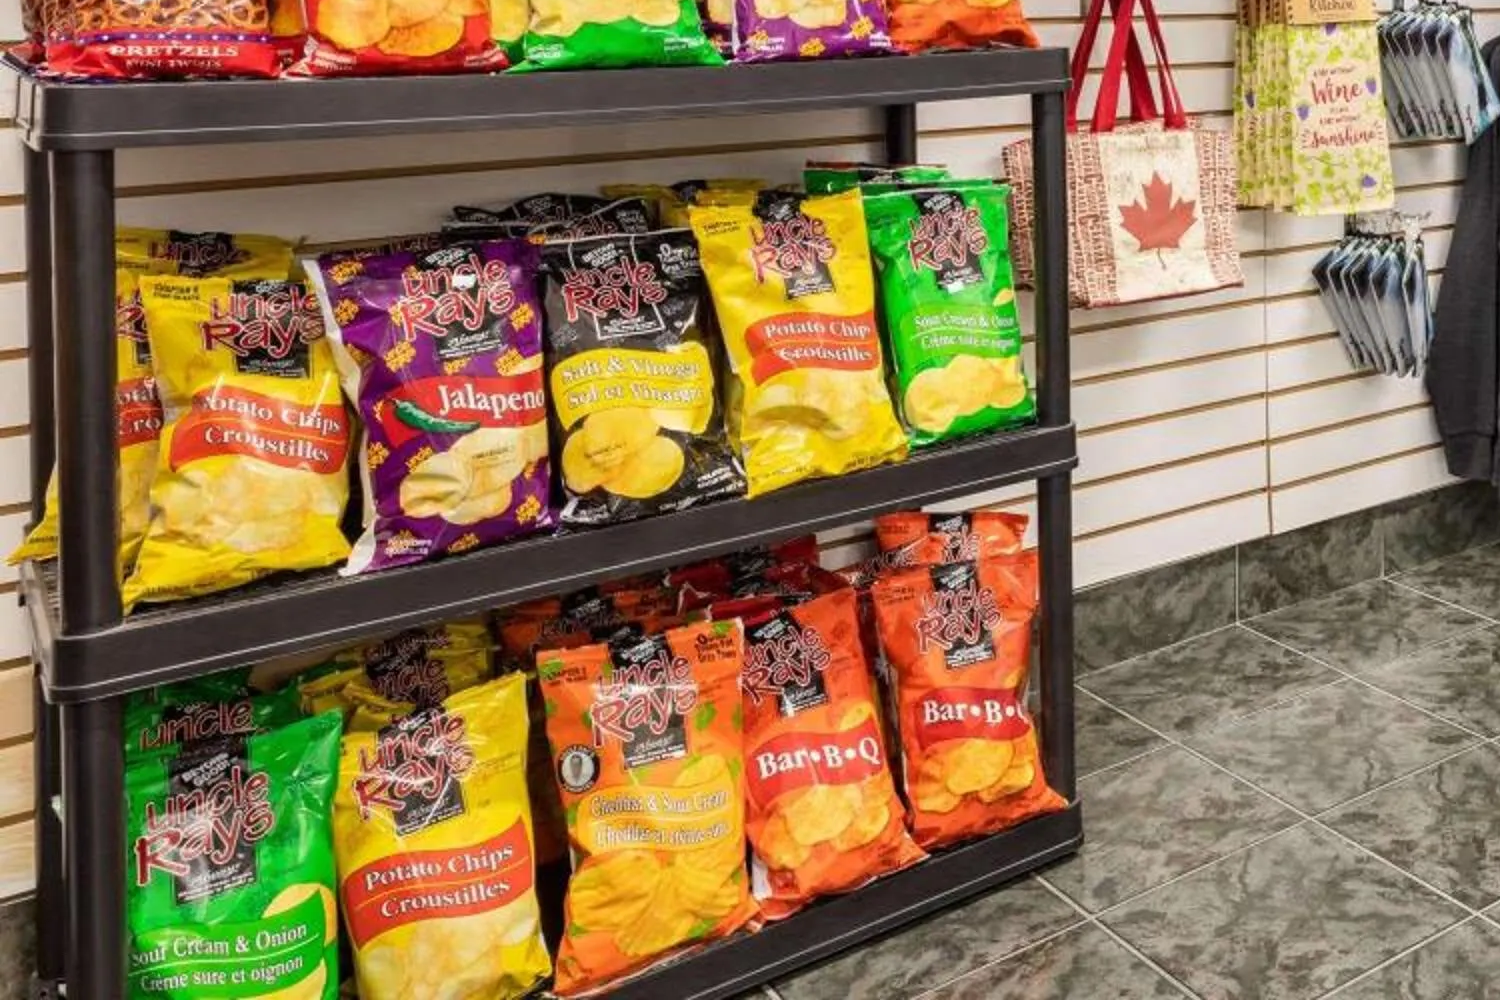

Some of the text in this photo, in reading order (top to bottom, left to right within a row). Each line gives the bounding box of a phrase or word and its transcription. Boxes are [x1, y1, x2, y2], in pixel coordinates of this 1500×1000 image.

[108, 42, 239, 58] PRETZELS
[764, 320, 825, 338] Potato
[562, 362, 602, 384] Salt
[607, 356, 624, 373] &
[281, 406, 342, 435] Chips
[205, 424, 331, 462] Croustilles
[365, 842, 514, 891] Potato Chips
[380, 877, 512, 919] Croustilles
[174, 935, 229, 958] Cream
[235, 935, 249, 954] &
[255, 923, 308, 950] Onion
[192, 970, 227, 988] sure
[231, 968, 246, 984] et
[251, 955, 305, 985] oignon
